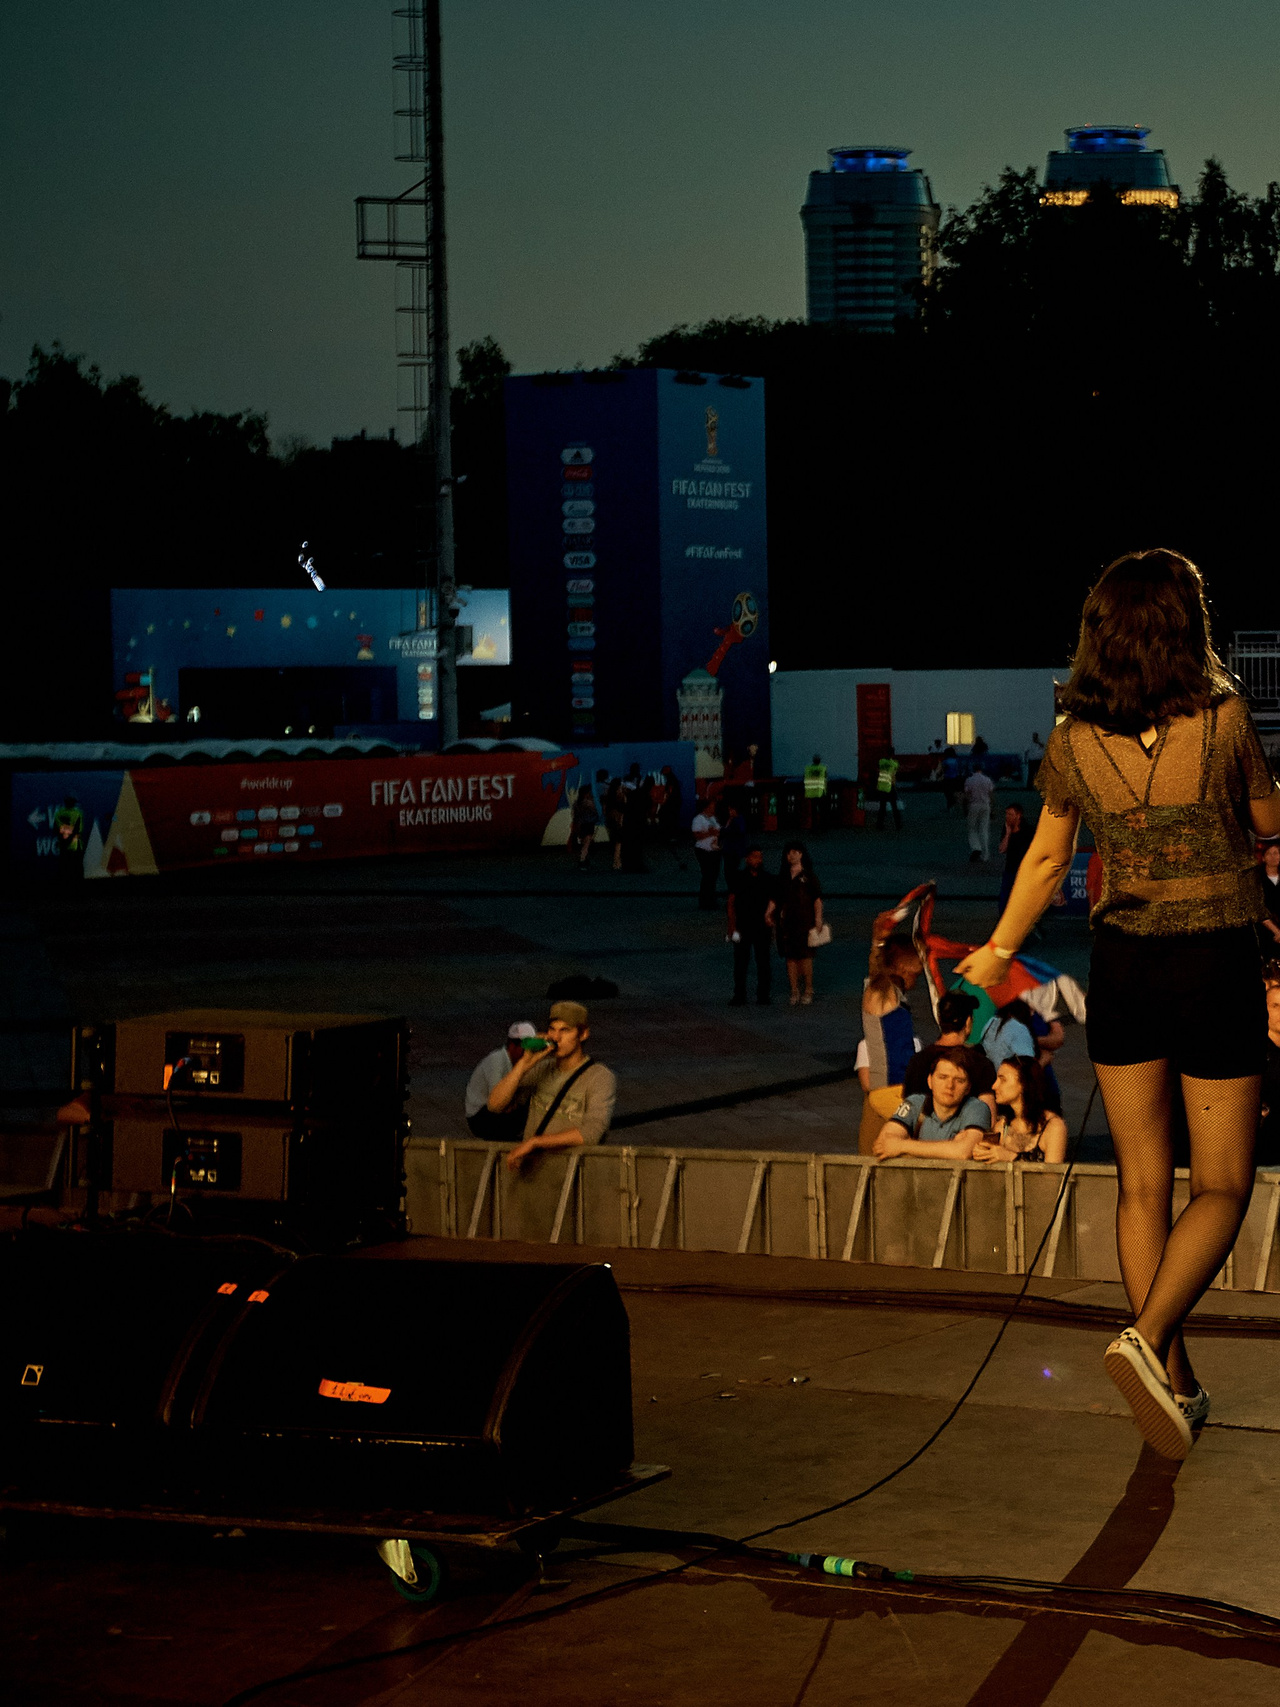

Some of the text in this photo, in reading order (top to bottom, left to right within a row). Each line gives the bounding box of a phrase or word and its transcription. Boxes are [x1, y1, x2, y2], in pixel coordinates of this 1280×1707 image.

[672, 479, 752, 498] FIFA FAN FEST
[569, 556, 590, 565] VISA
[240, 776, 294, 792] #worldcup
[370, 773, 517, 806] FIFA FAN FEST
[398, 802, 493, 827] EKATERINBURG
